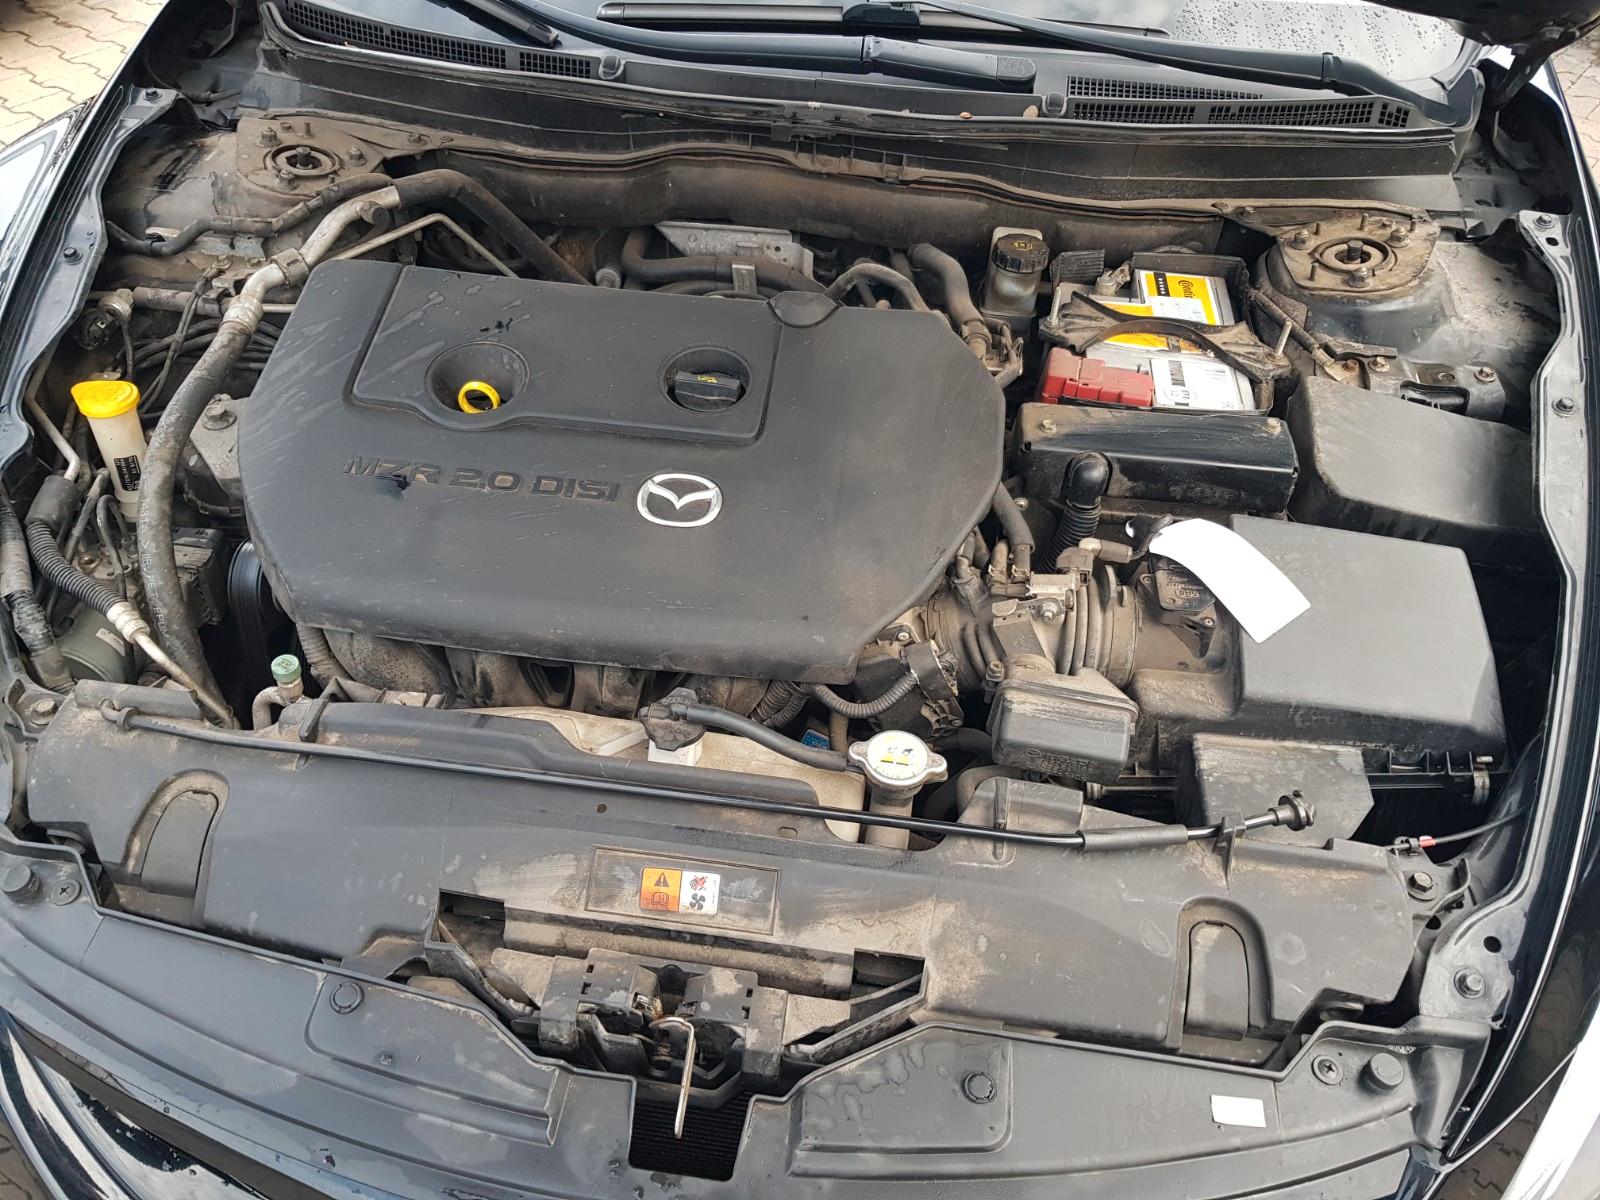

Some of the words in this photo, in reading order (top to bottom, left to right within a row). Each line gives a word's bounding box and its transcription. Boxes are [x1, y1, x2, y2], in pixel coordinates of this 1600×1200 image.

[343, 456, 443, 484] MZR
[449, 467, 521, 492] 2.0
[531, 475, 620, 501] DISI
